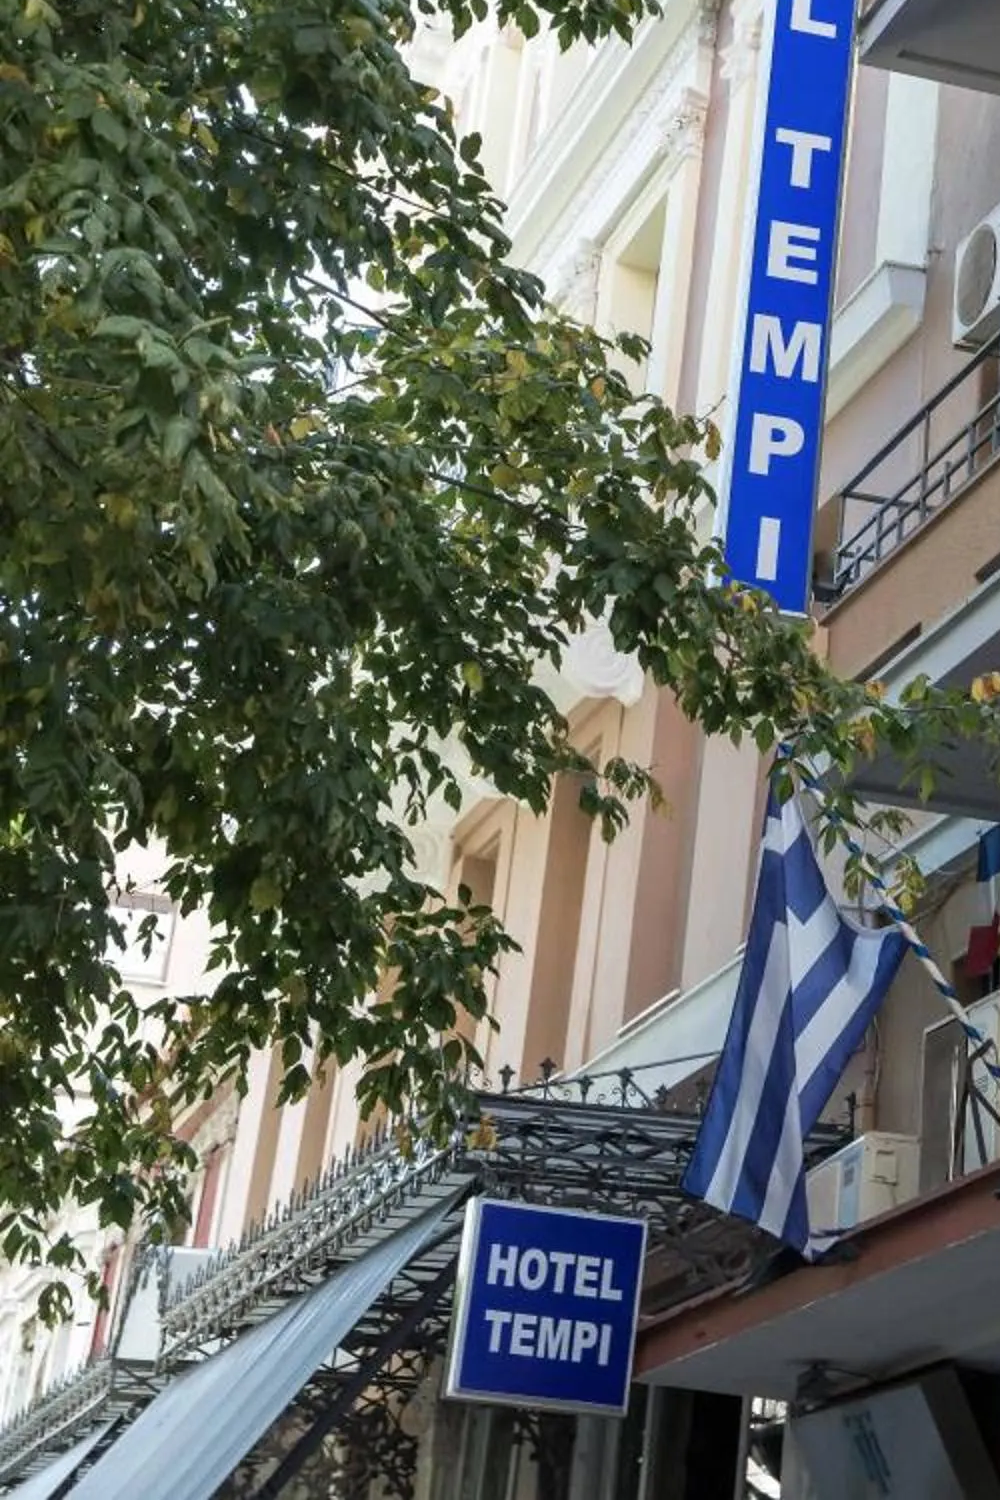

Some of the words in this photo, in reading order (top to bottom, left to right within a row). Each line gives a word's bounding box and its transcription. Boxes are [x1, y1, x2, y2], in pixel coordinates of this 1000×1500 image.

[749, 127, 832, 581] TEMPI
[487, 1243, 623, 1301] HOTEL
[484, 1309, 613, 1366] TEMPI
